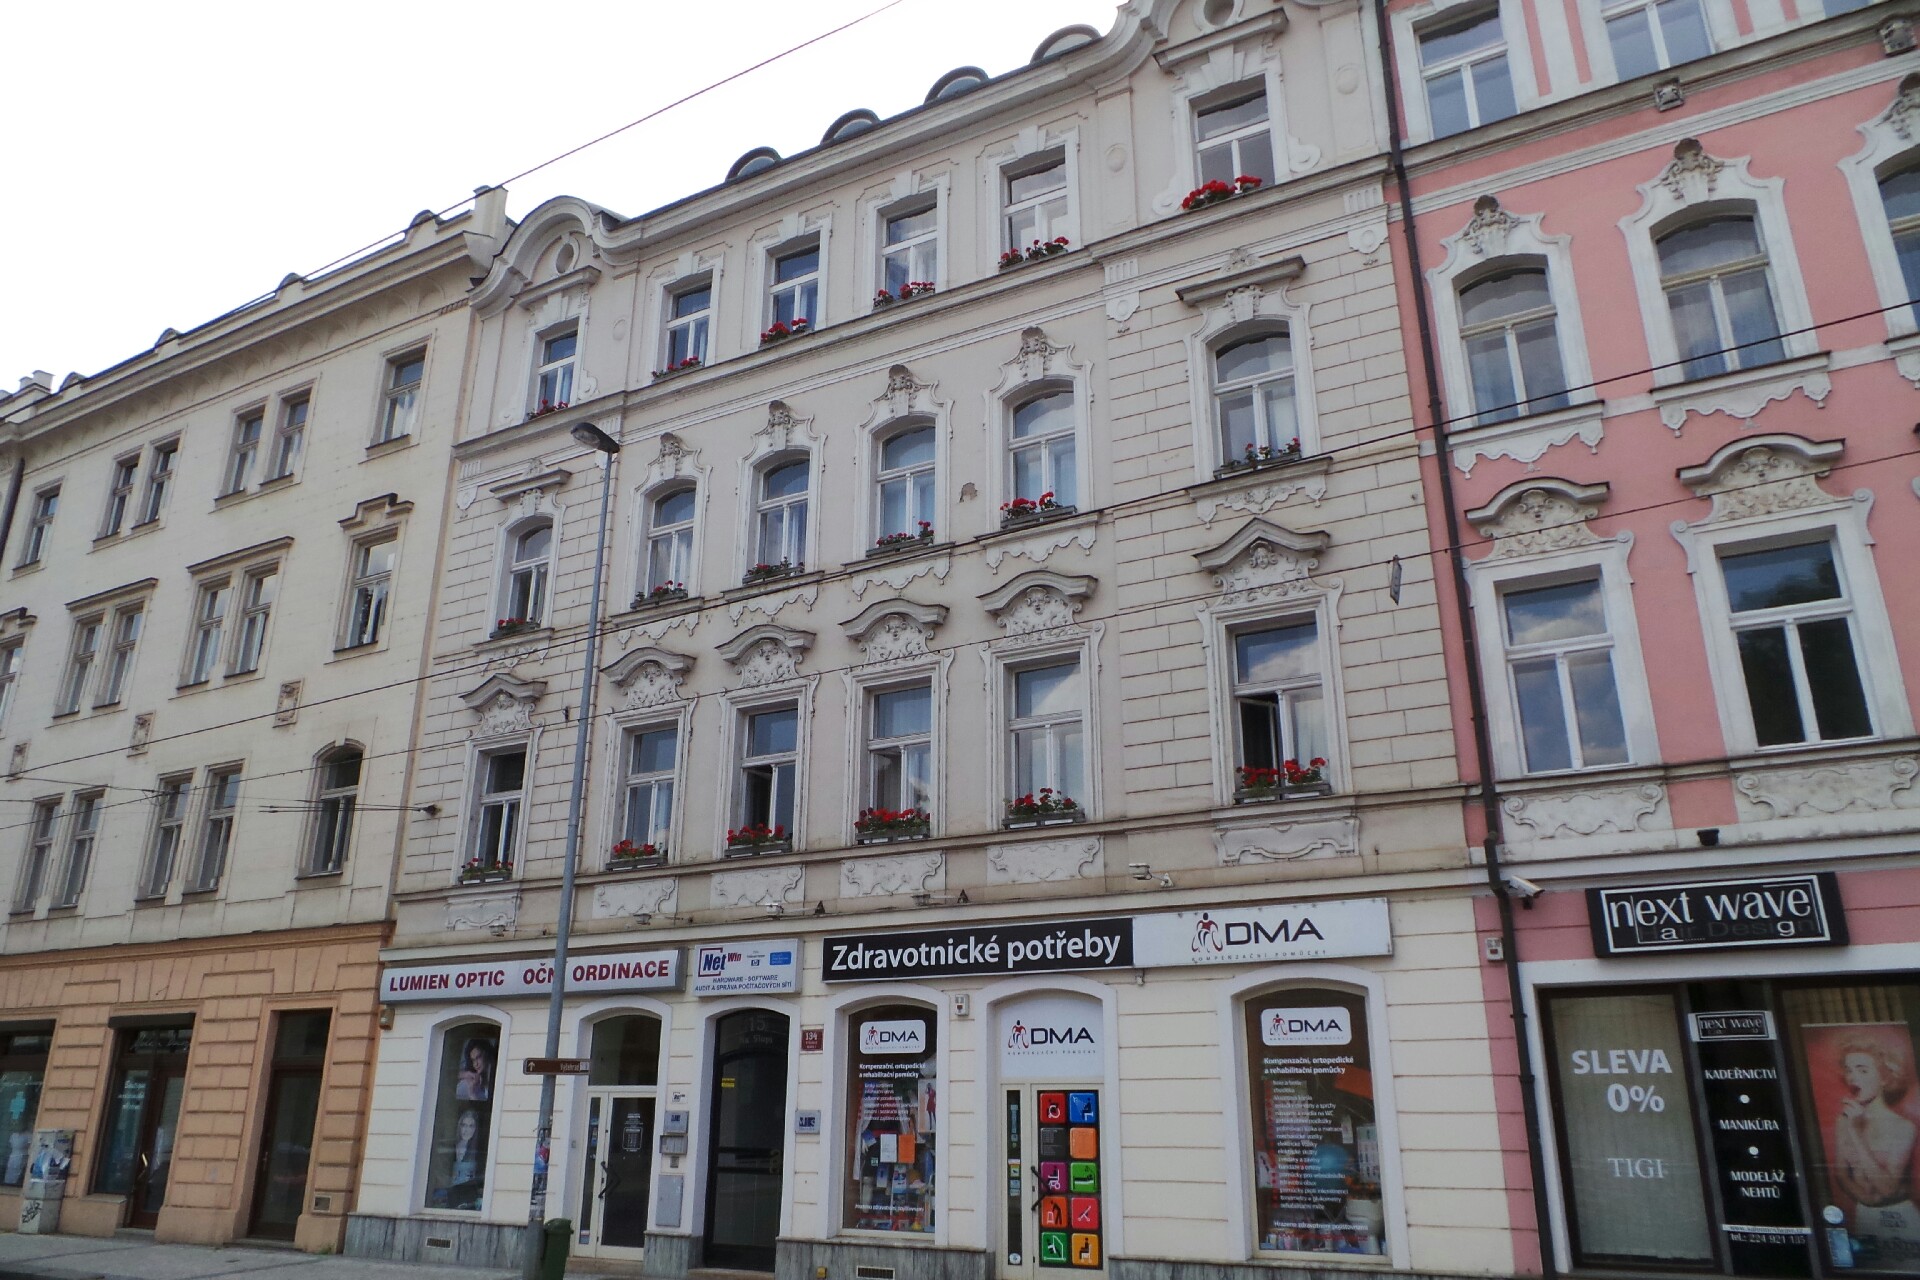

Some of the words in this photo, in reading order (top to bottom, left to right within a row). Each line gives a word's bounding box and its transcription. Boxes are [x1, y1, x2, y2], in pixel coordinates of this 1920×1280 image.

[1610, 891, 1694, 928] next
[1705, 888, 1811, 921] wave
[1225, 918, 1324, 945] DMA
[831, 935, 1000, 971] Zdravotnické
[1007, 929, 1121, 968] potřeby
[703, 953, 727, 971] Net
[727, 952, 742, 962] Win
[389, 974, 450, 991] LUMIEN
[455, 970, 505, 988] OPTIC
[572, 960, 670, 982] ORDINACE
[1288, 1019, 1342, 1032] DMA
[805, 1032, 818, 1040] 134
[880, 1030, 920, 1042] DMA
[1031, 1027, 1095, 1044] DMA
[1312, 1056, 1354, 1065] ortopedické
[1571, 1049, 1673, 1075] SLEVA
[1270, 1066, 1312, 1074] rehabilitační
[1313, 1066, 1346, 1075] pomůcky
[1704, 1067, 1777, 1079] KADEŘNICTVÍ
[1607, 1083, 1665, 1113] 0%
[1720, 1118, 1780, 1130] MANIKÚRA
[1608, 1158, 1664, 1179] TIGI
[1730, 1170, 1786, 1182] MODELÁŽ
[1741, 1185, 1780, 1198] NEHTŮ
